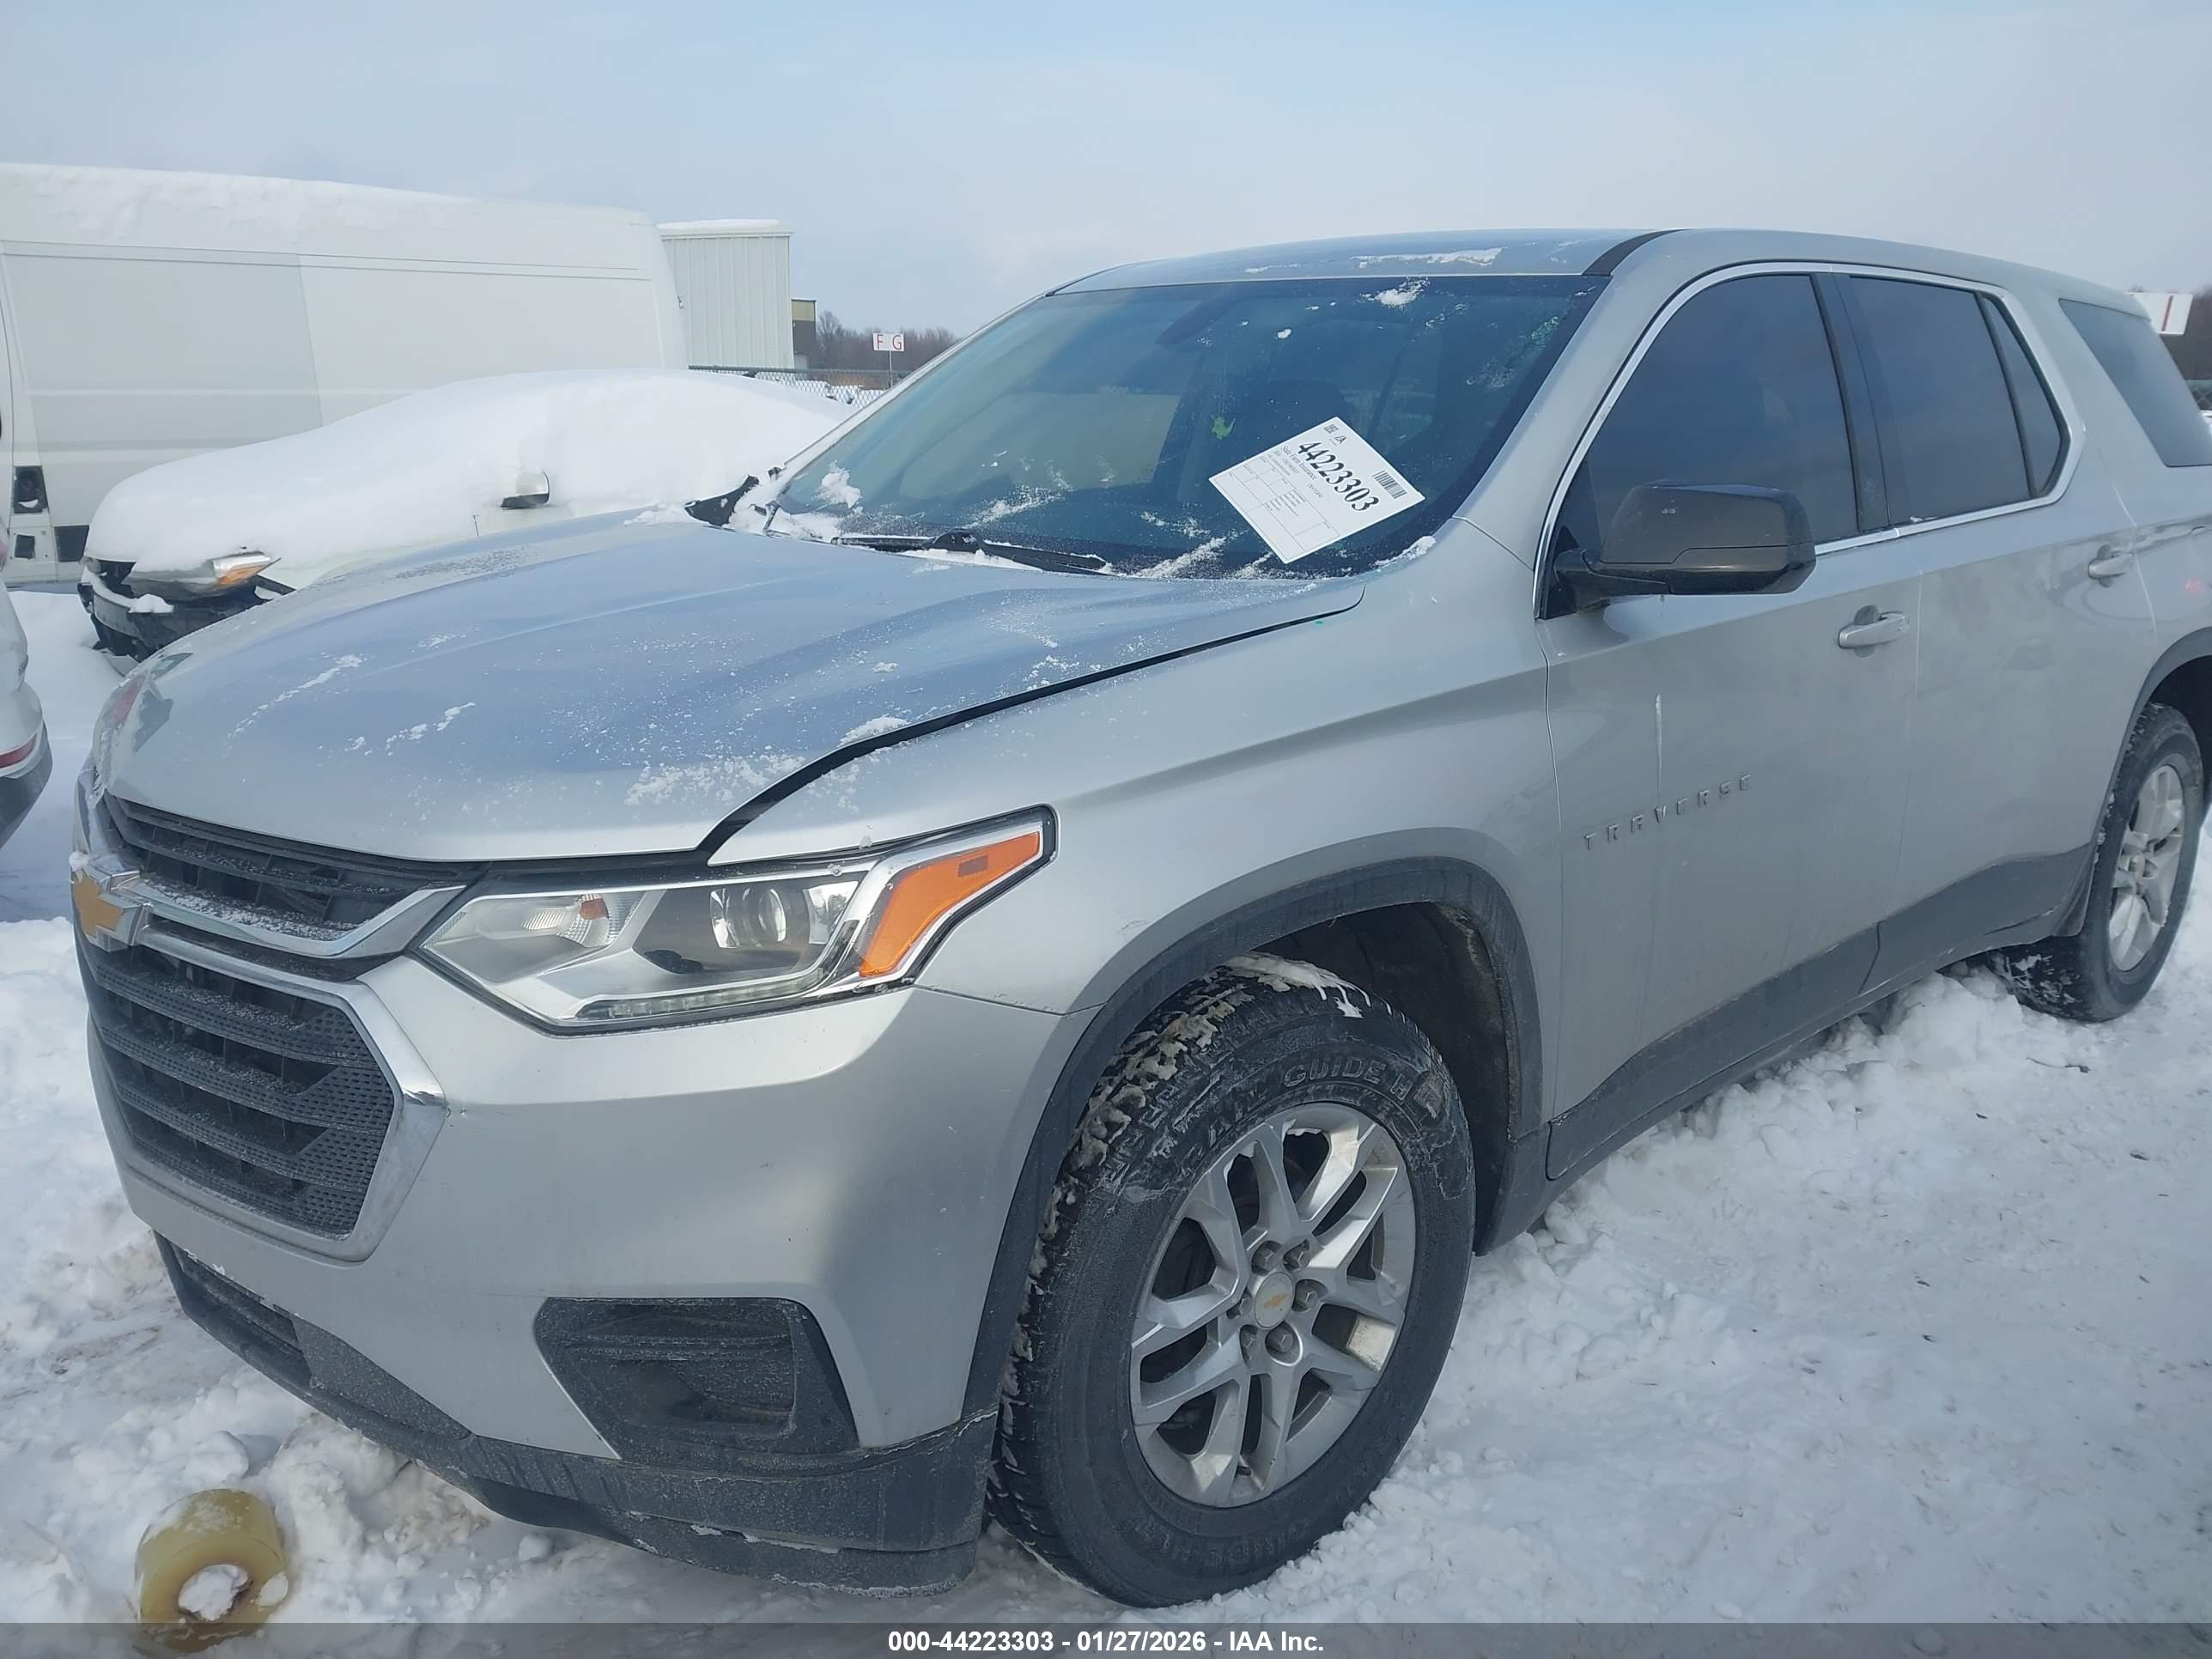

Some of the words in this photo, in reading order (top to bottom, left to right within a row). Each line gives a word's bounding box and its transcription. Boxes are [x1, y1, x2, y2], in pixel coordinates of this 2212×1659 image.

[877, 333, 884, 349] F
[892, 334, 902, 350] G
[1297, 441, 1380, 512] 44223303
[1583, 774, 1752, 851] TRAVERSE
[1284, 1055, 1388, 1088] GUIDE
